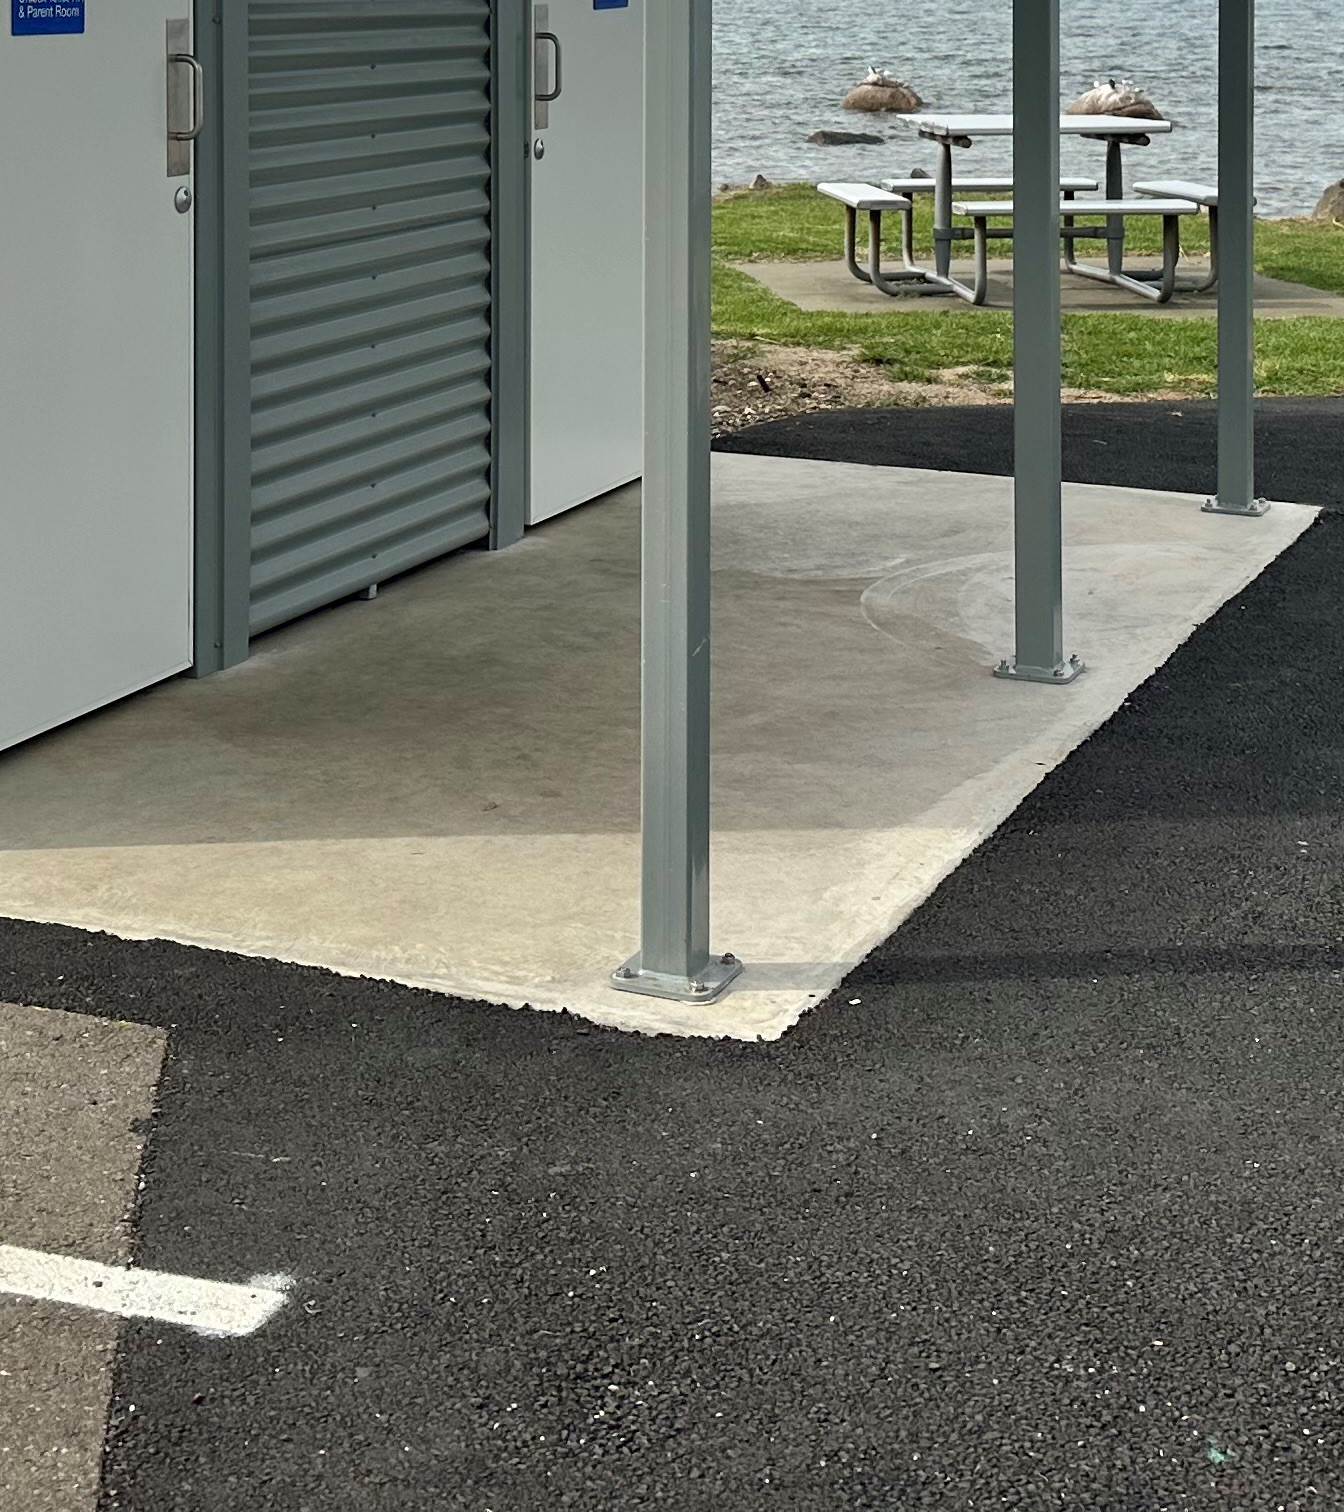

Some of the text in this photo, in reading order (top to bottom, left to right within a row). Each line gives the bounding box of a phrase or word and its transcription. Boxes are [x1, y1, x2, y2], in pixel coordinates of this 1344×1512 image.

[18, 4, 80, 19] & Parent Room
